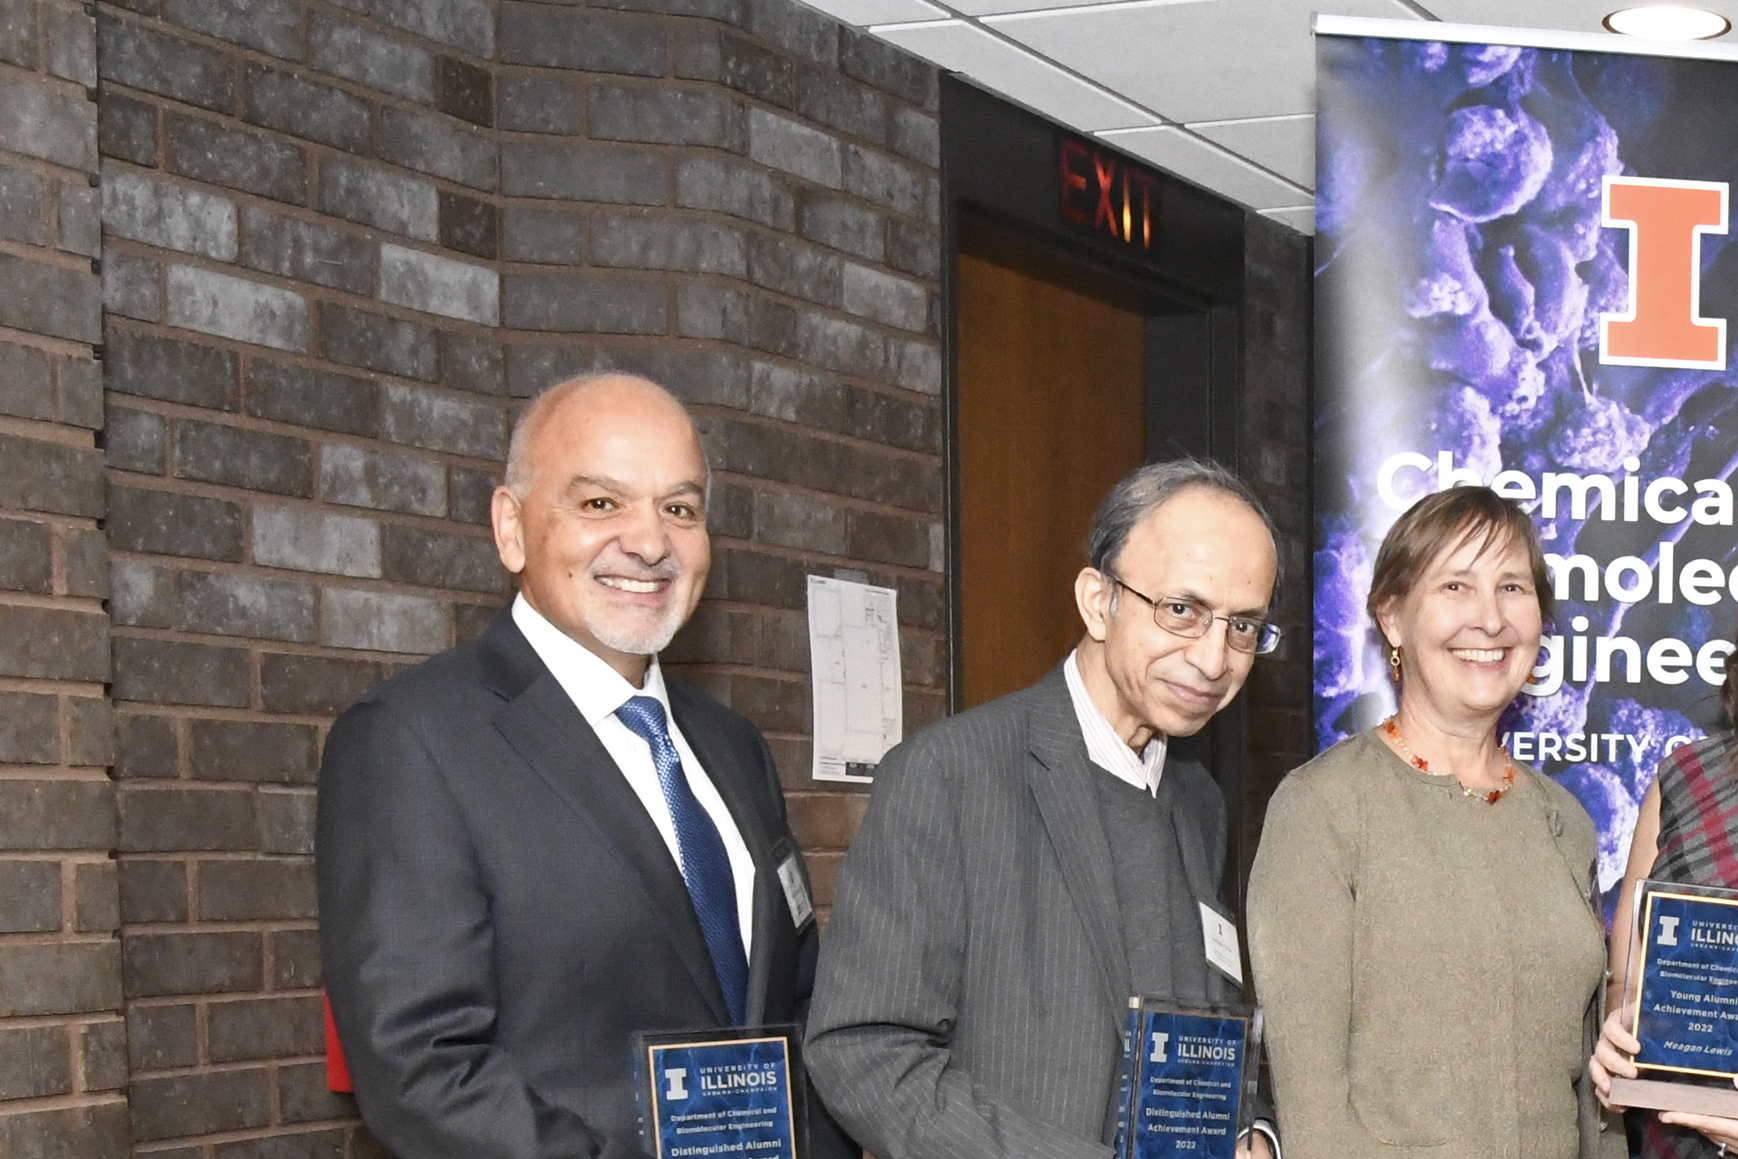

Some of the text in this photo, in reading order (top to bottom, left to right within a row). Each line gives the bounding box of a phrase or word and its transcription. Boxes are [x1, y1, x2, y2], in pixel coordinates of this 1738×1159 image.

[1061, 140, 1157, 249] EXIT
[1657, 958, 1699, 968] Department
[1671, 990, 1738, 1005] Young Alumni
[1653, 1004, 1717, 1018] Achievement
[1688, 1023, 1713, 1032] 2022
[1178, 1044, 1235, 1060] ILLINOIS
[1664, 1041, 1702, 1052] Meagan
[700, 1064, 758, 1074] UNIVERSITY
[701, 1071, 777, 1090] ILLINOIS
[671, 1112, 715, 1122] Department
[727, 1108, 761, 1117] Chemical
[1146, 1108, 1230, 1120] Distinguished Alumni
[729, 1121, 773, 1130] Engineering
[1148, 1124, 1226, 1135] Achievement Award
[671, 1138, 781, 1156] Distinguished Alumni
[1176, 1141, 1196, 1149] 2022
